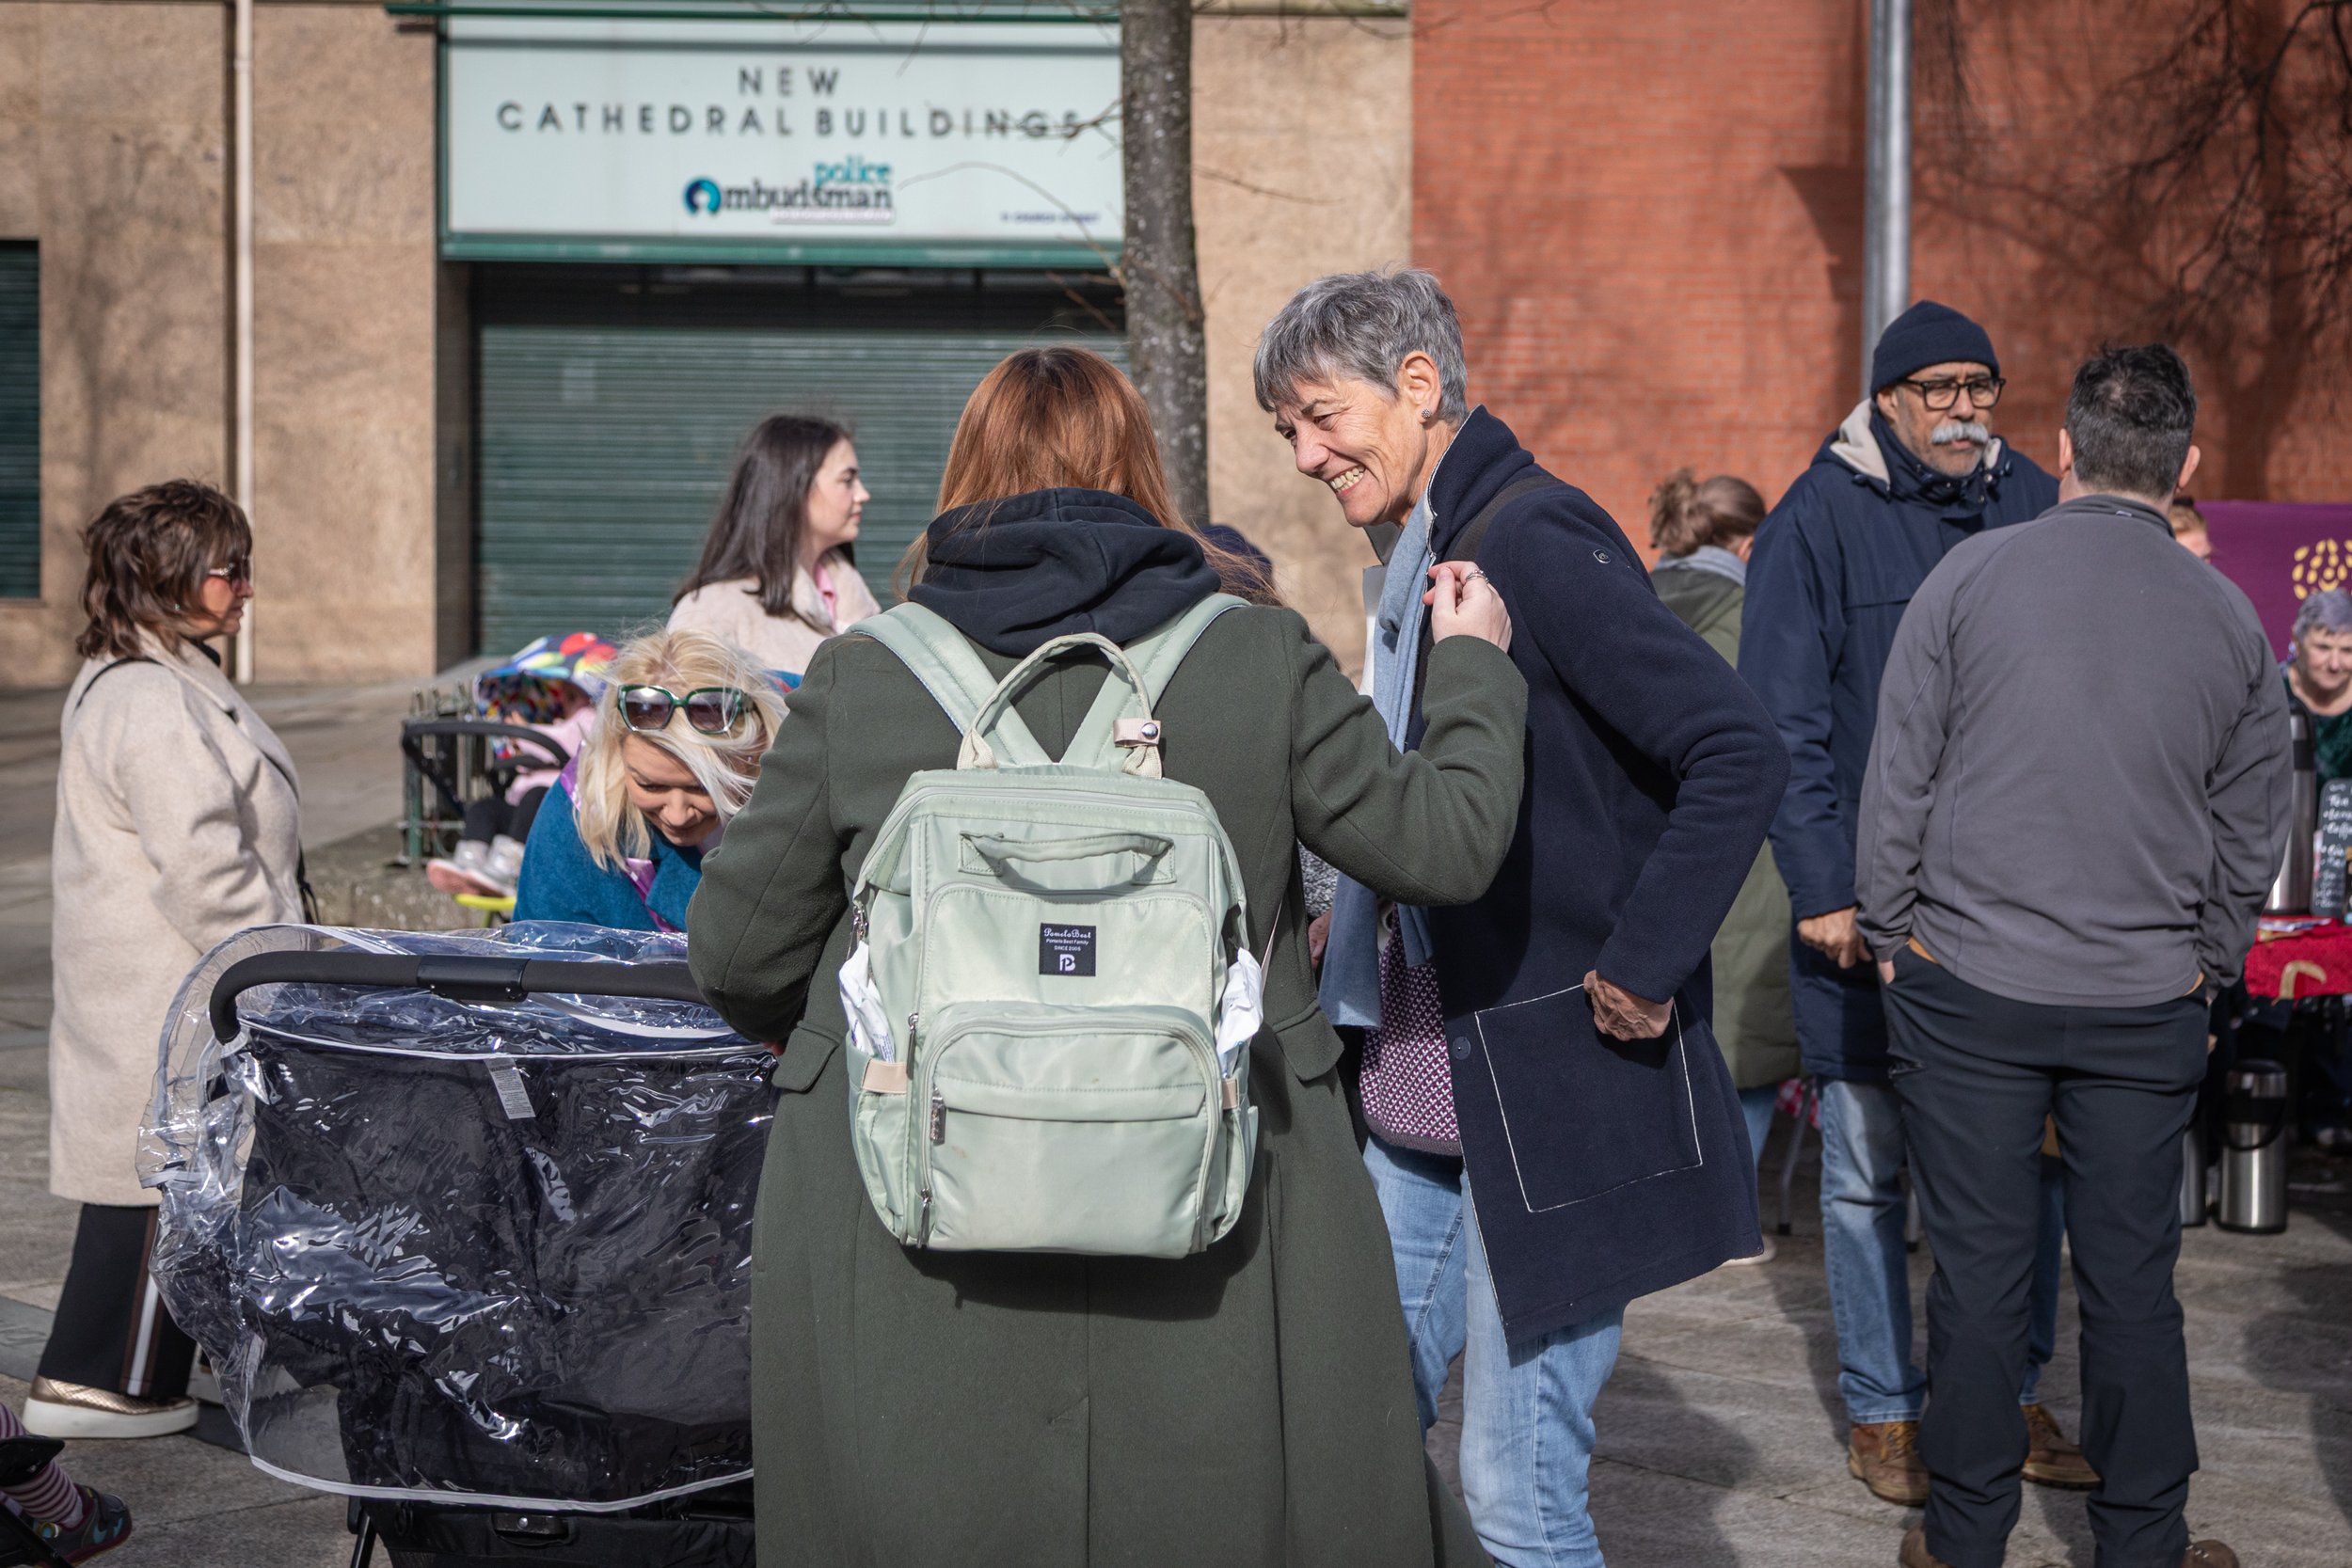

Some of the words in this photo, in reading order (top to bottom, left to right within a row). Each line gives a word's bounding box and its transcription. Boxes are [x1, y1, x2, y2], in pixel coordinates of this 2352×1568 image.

[739, 67, 839, 96] NEW
[496, 102, 794, 134] CATHEDRAL
[815, 107, 1081, 138] BUILDINGS
[814, 156, 892, 185] police
